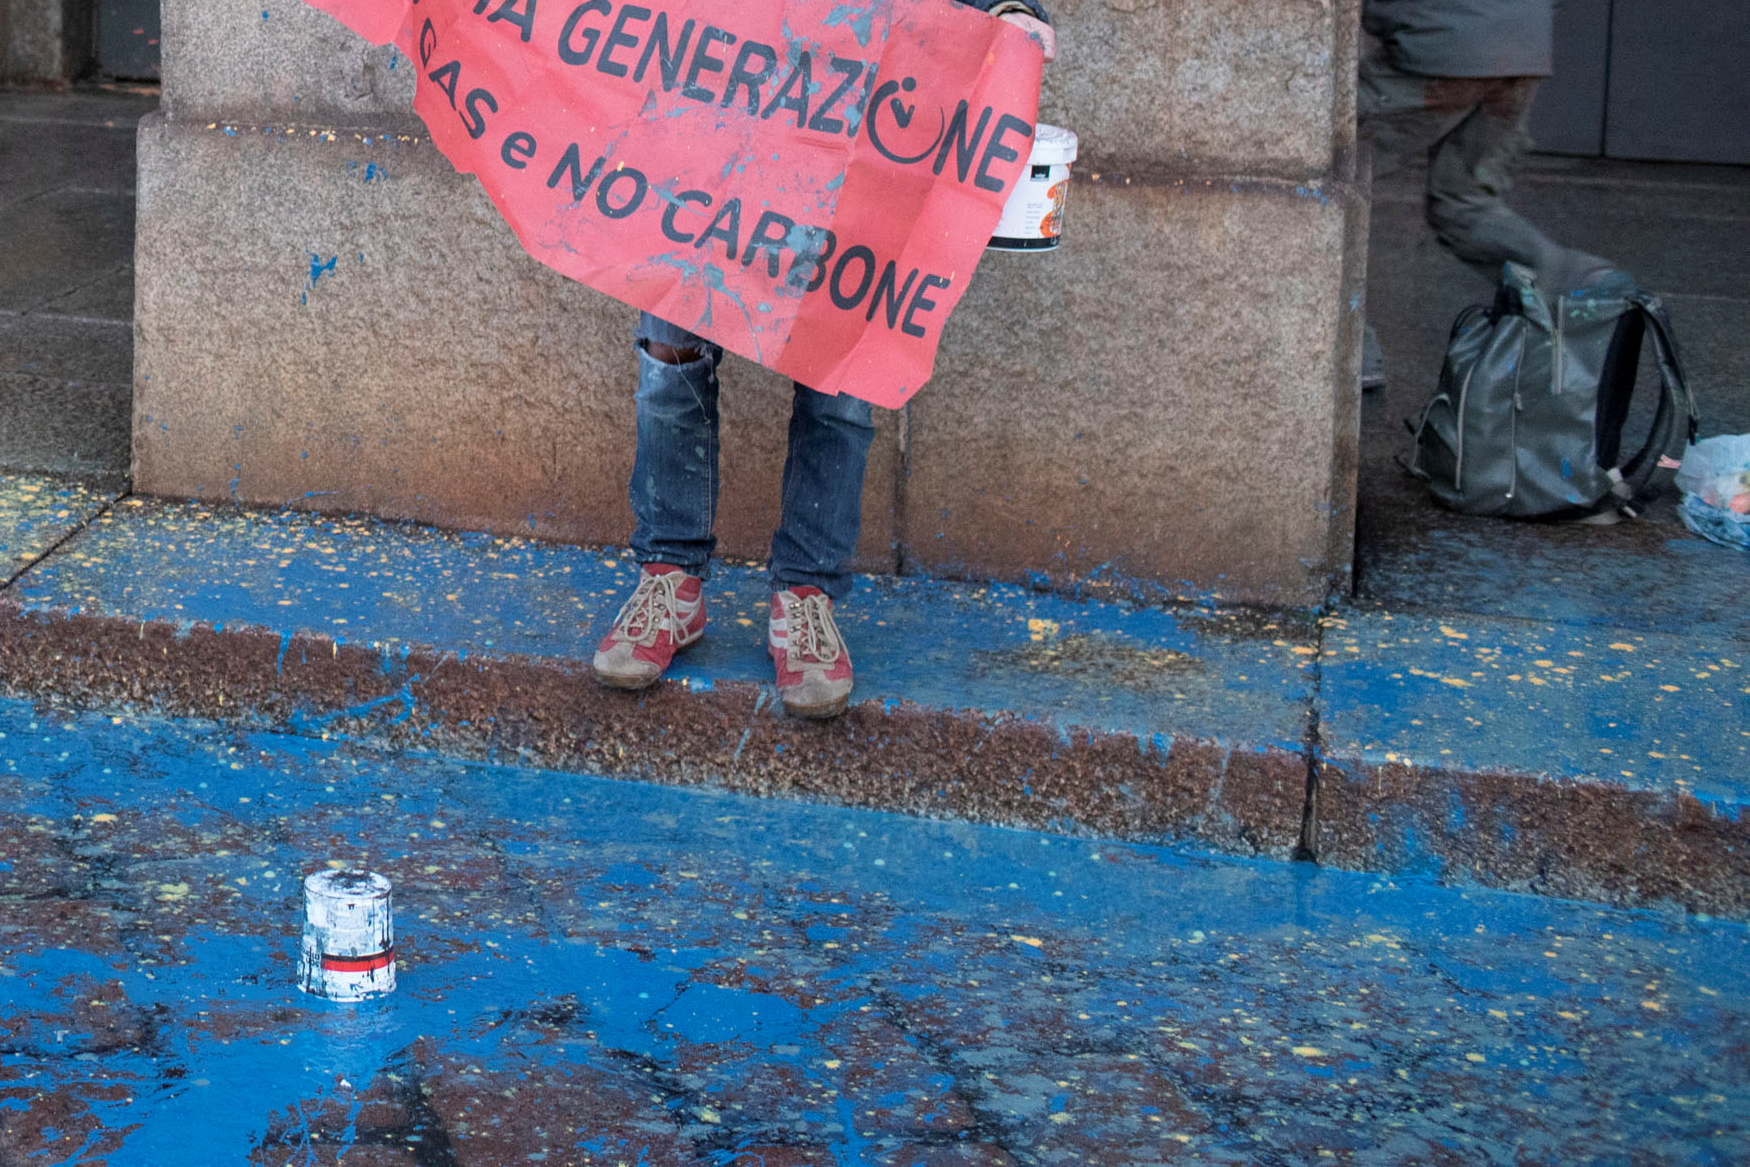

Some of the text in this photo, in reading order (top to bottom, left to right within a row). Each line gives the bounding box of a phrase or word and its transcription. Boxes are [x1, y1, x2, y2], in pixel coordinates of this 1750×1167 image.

[418, 17, 499, 140] GAS
[500, 129, 537, 170] e
[547, 142, 648, 220] NO
[660, 188, 950, 339] CARBONE
